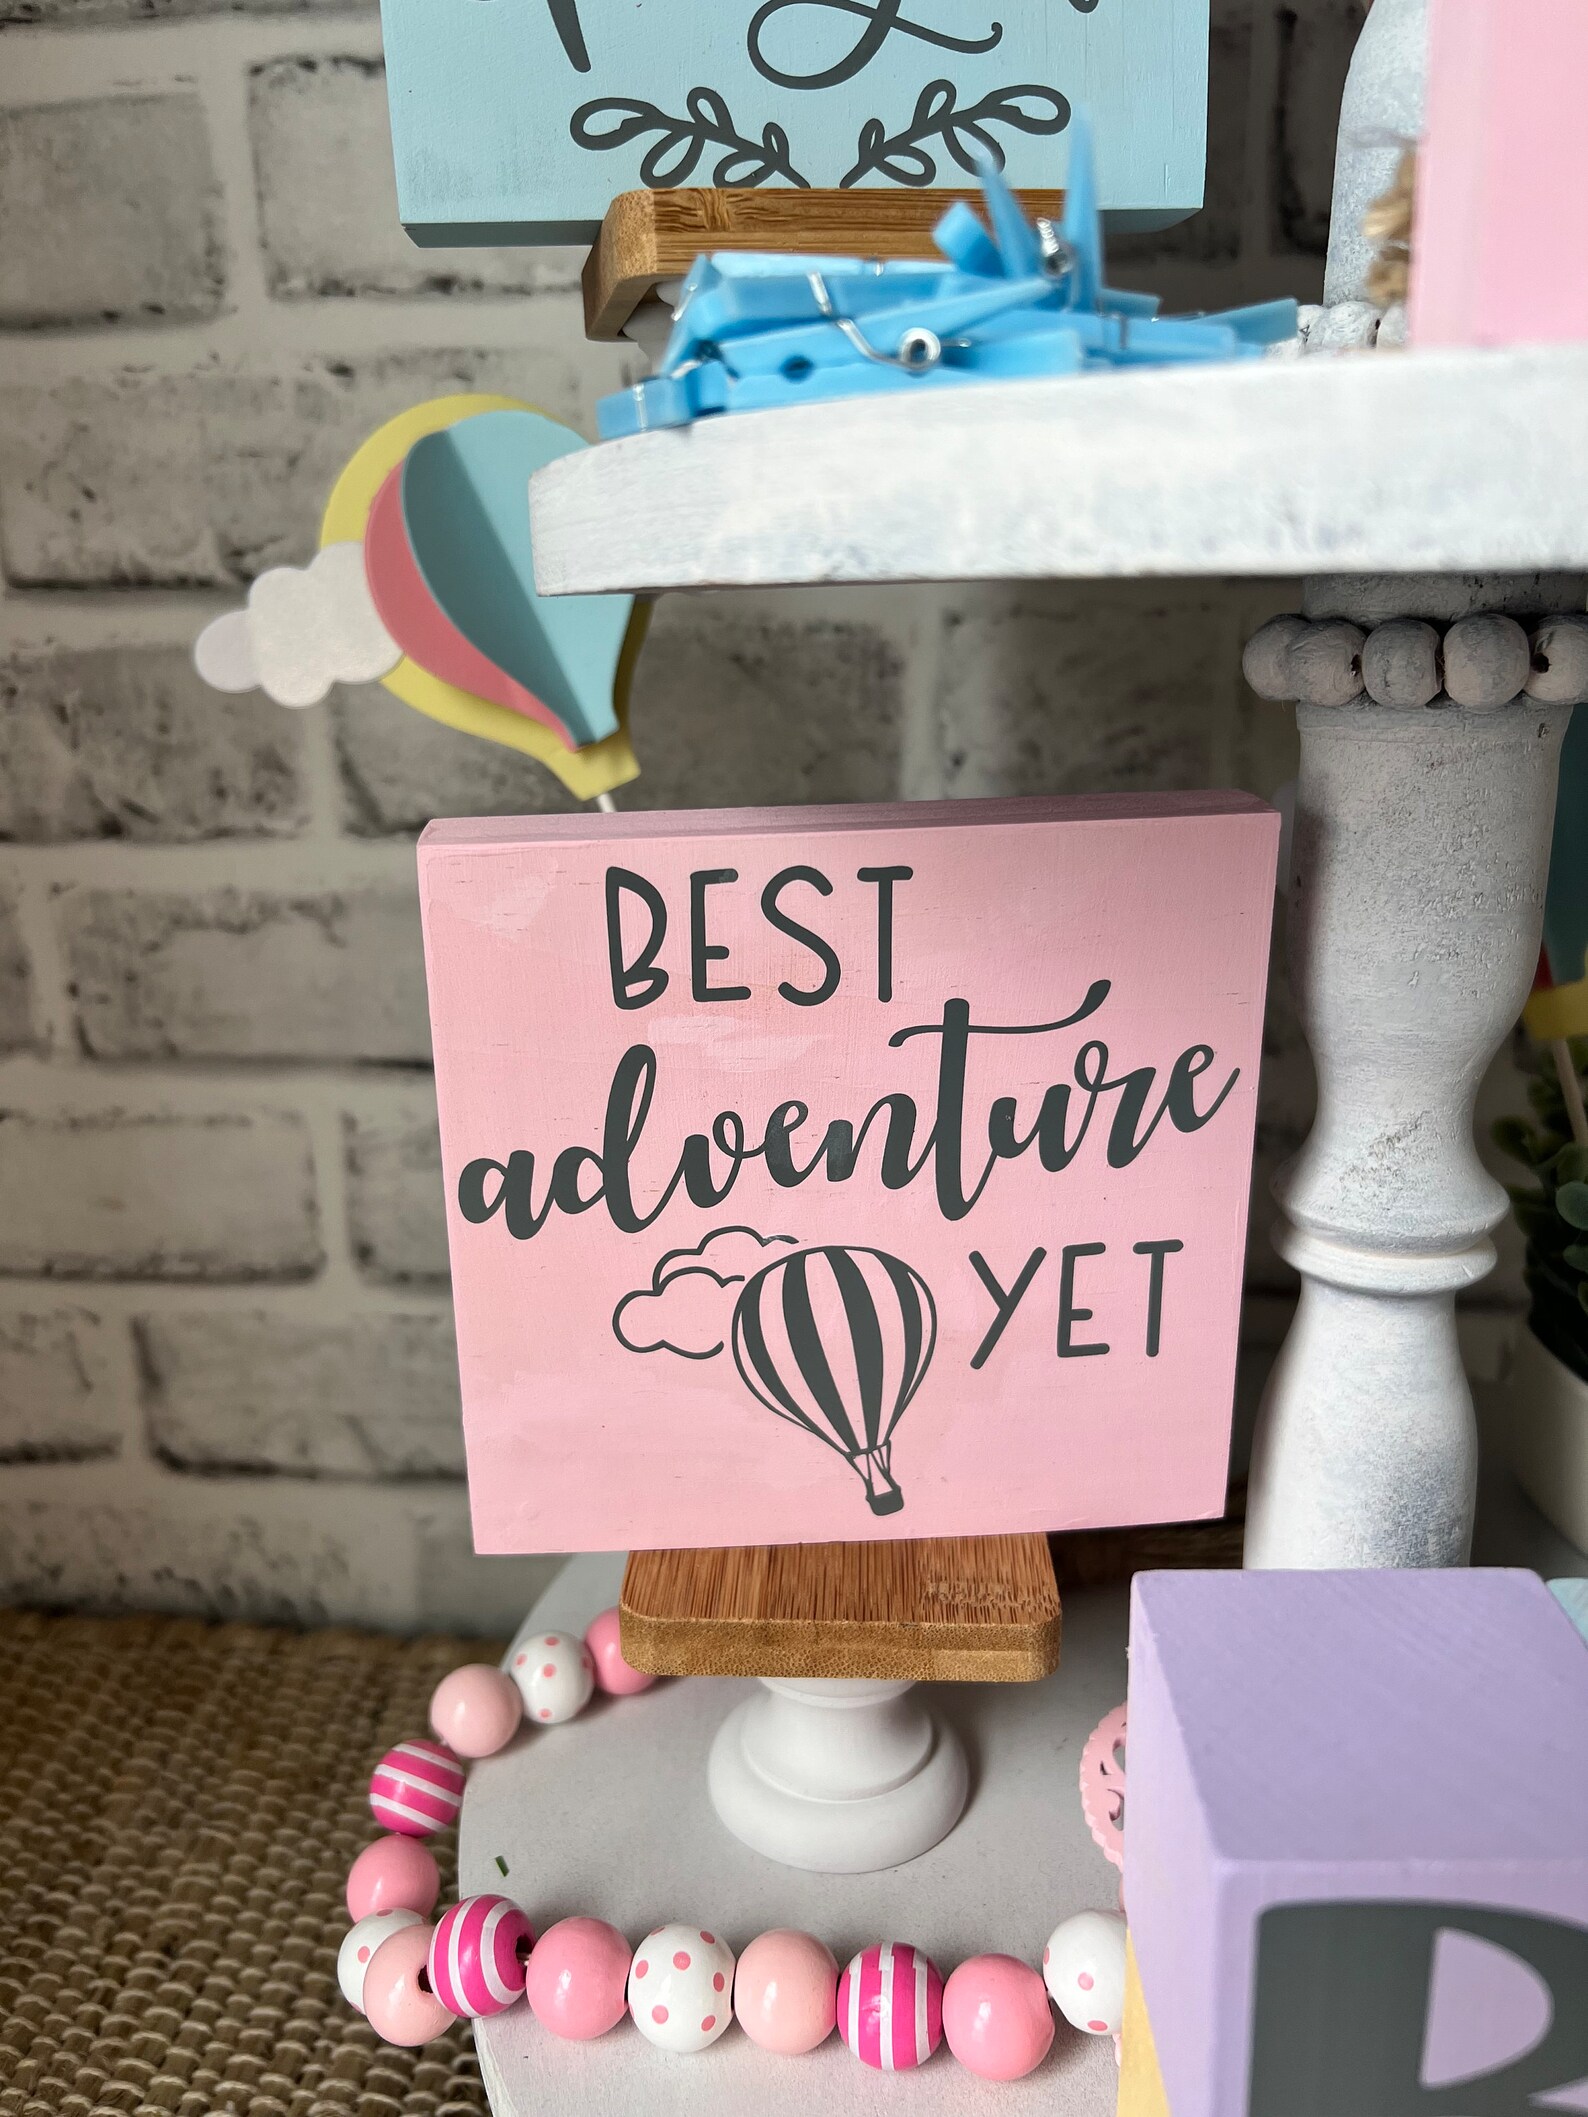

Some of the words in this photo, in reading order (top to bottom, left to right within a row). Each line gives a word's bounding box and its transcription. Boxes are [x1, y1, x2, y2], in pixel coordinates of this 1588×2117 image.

[605, 864, 914, 1011] BEST
[457, 979, 1241, 1241] adventure
[968, 1239, 1184, 1370] YET
